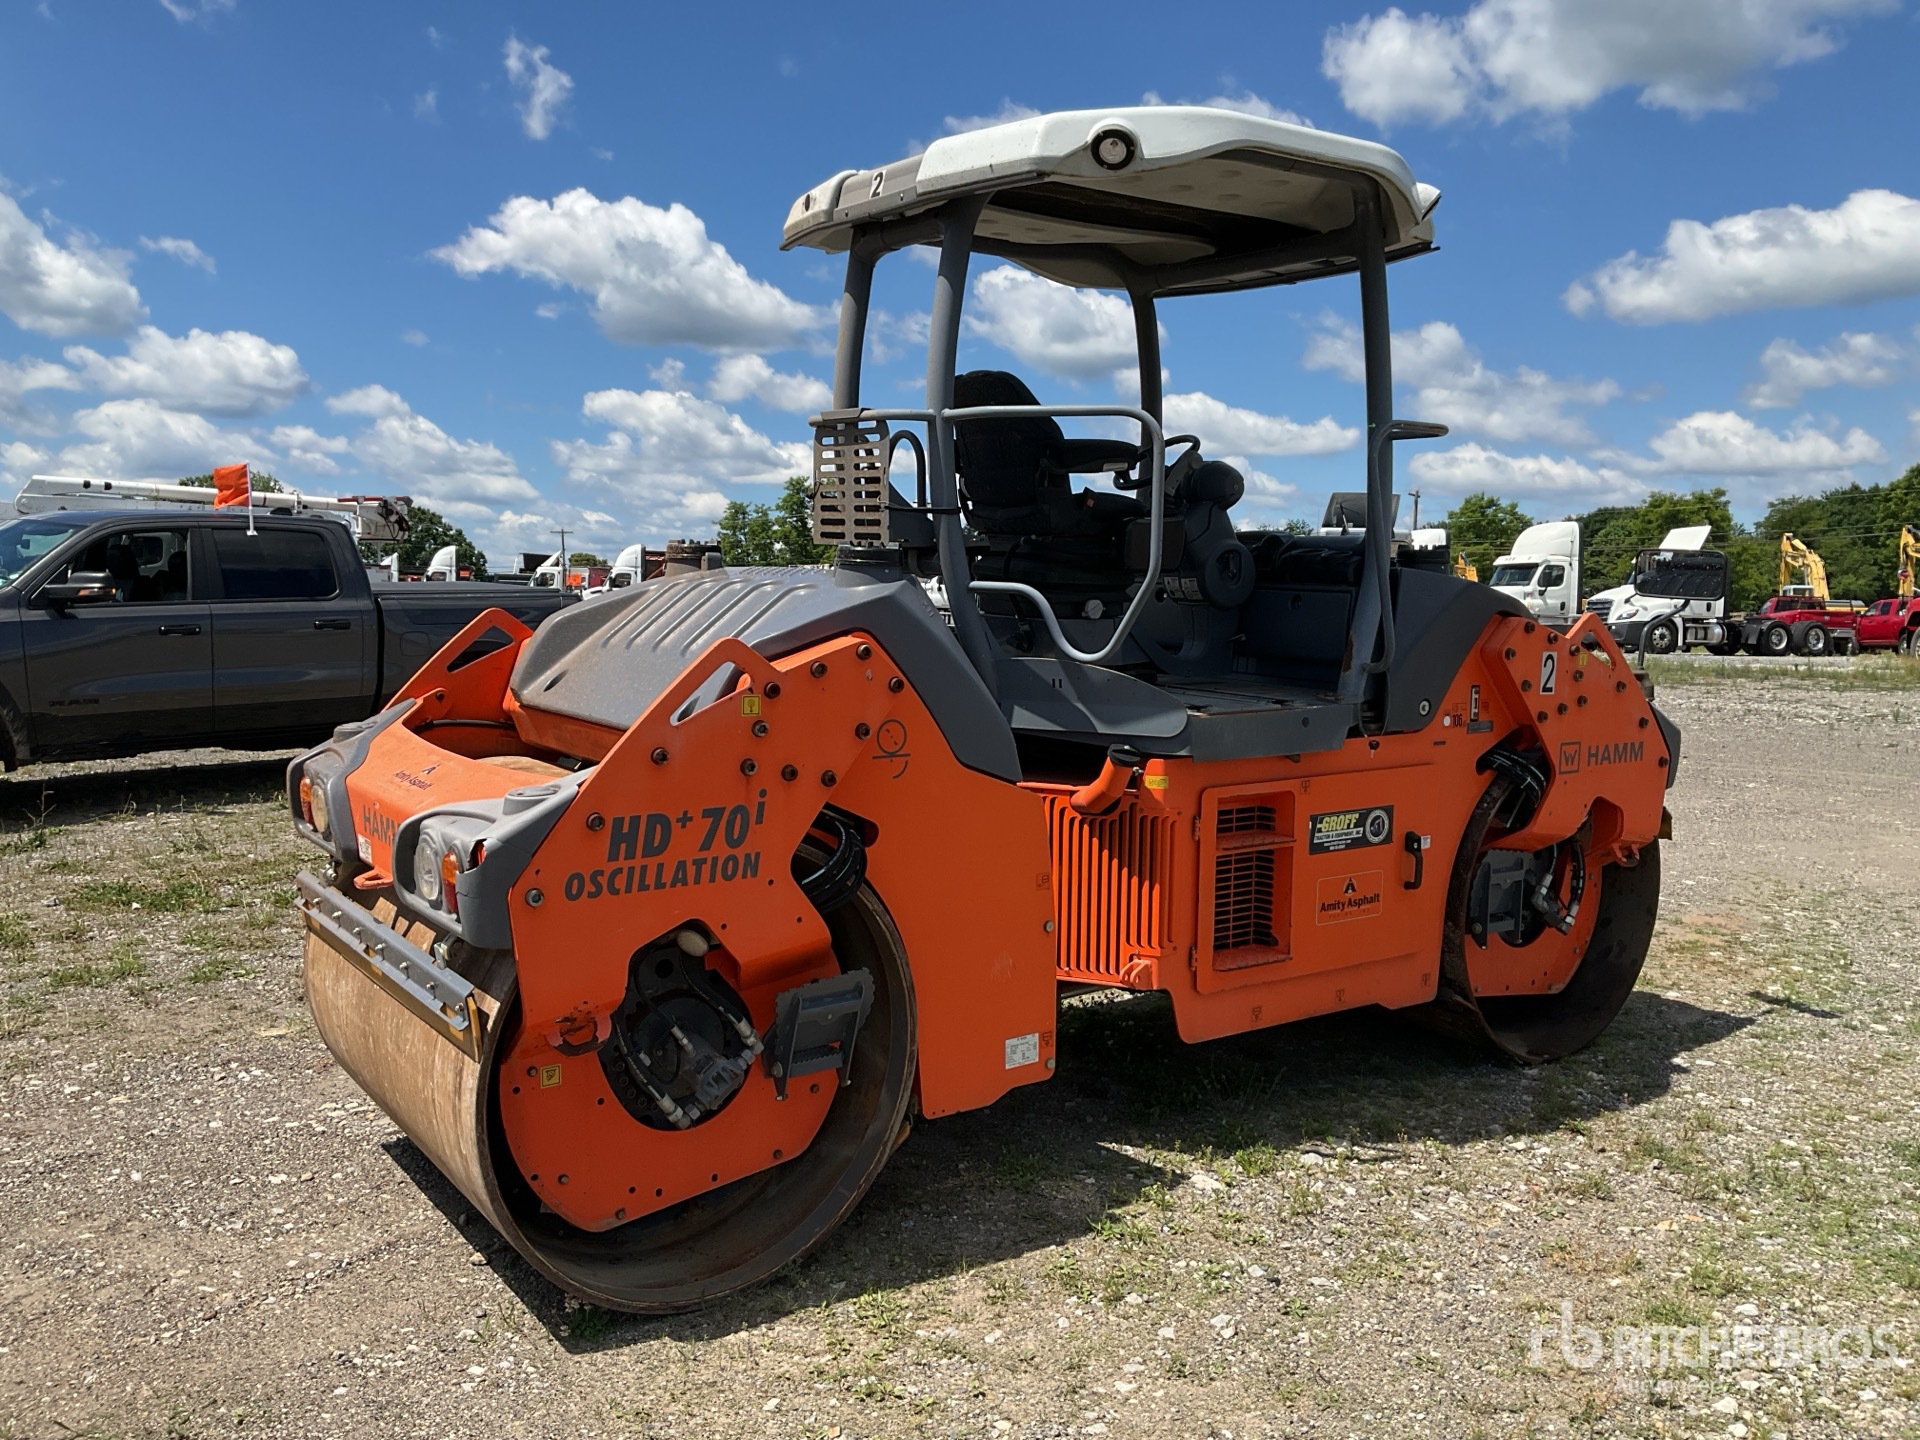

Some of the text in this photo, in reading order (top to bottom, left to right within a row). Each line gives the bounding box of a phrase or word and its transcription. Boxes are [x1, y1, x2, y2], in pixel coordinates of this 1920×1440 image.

[870, 171, 884, 199] 2
[1541, 653, 1555, 693] 2
[1452, 713, 1463, 728] 106
[1587, 741, 1644, 768] HAMM
[1321, 812, 1359, 832] GROFF
[564, 851, 761, 901] OSCILLATION
[1320, 900, 1346, 912] Amity
[1347, 893, 1380, 909] Asphalt
